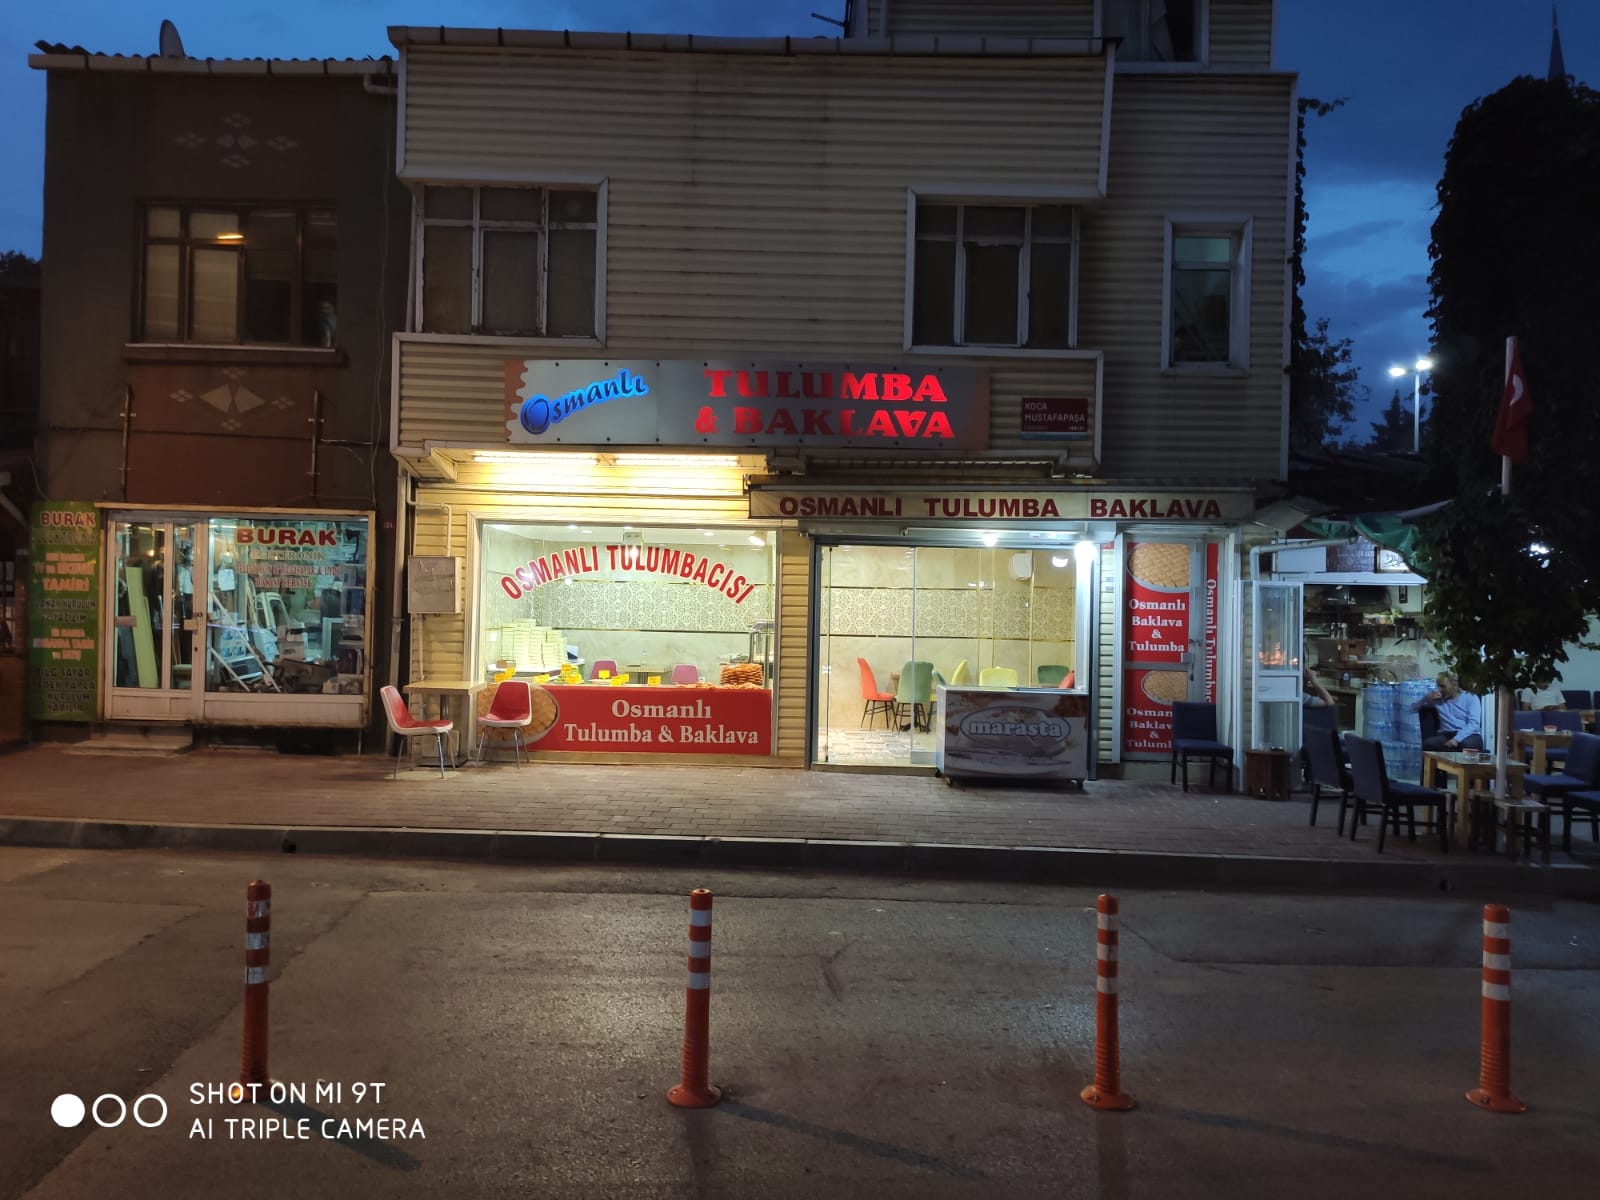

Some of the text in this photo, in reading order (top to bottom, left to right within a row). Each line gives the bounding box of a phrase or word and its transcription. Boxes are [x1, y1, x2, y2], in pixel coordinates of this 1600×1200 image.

[704, 370, 948, 403] TULUMBA
[520, 368, 651, 434] Osmanlı
[1024, 402, 1048, 411] KOCA
[695, 406, 956, 440] & BAKLAVA
[1024, 413, 1086, 423] MUSTAFAPAŞA
[779, 495, 1222, 520] OSMANLI TULUMBA BAKLAVA
[40, 511, 96, 527] BURAK
[236, 528, 338, 546] BURAK
[500, 543, 756, 605] OSMANLI TULUMBACISI
[1128, 598, 1186, 611] Osmanlı
[1131, 615, 1183, 627] Baklava
[1151, 629, 1163, 639] &
[1205, 579, 1217, 703] Osmanlı Tulumbac
[1128, 640, 1185, 652] Tulumba
[611, 699, 712, 719] Osmanlı
[1126, 707, 1174, 717] Osman
[564, 722, 759, 745] Tulumba & Baklava
[968, 720, 1063, 738] marasta
[1129, 720, 1173, 730] Baklav
[1149, 730, 1160, 739] &
